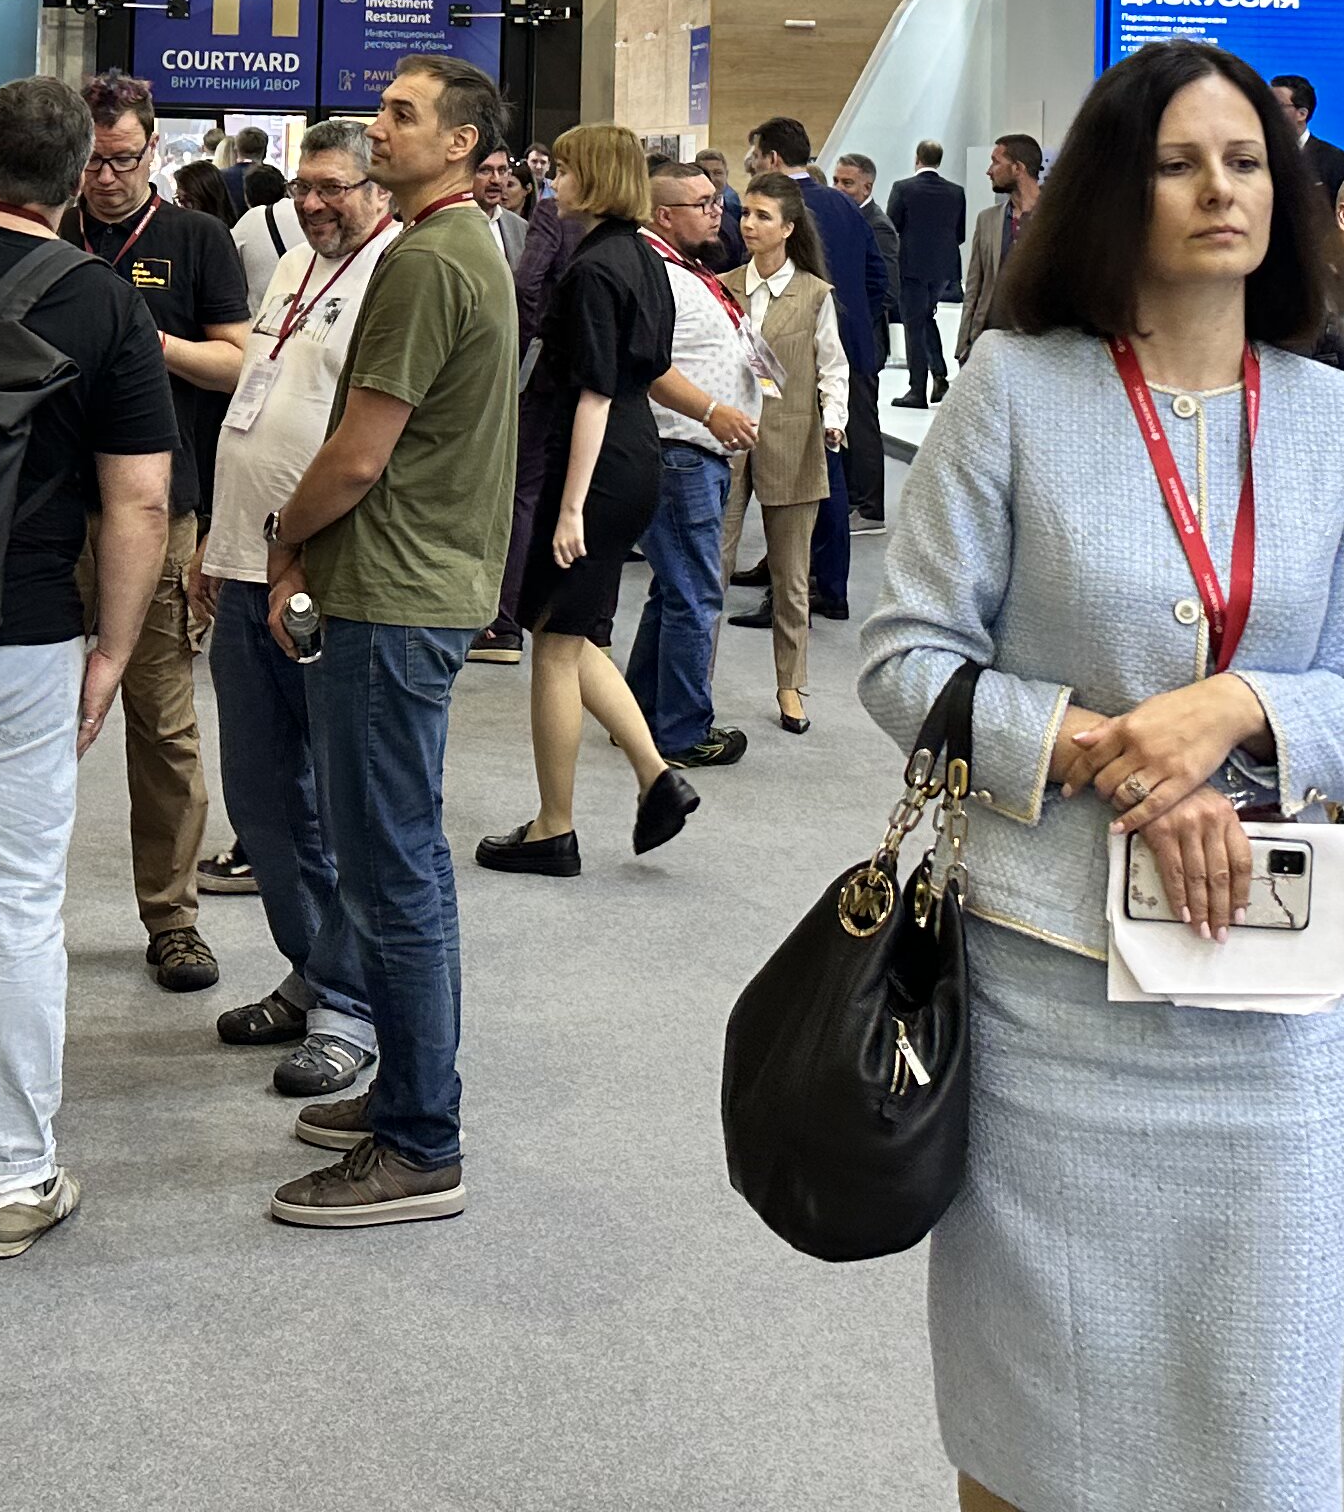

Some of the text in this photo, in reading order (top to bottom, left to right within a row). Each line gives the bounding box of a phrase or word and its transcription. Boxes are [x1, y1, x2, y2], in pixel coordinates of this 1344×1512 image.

[365, 10, 431, 24] Restaurant
[161, 49, 301, 73] COURTYARD
[170, 75, 301, 92] ВНУТРЕННИЙ ДВОР
